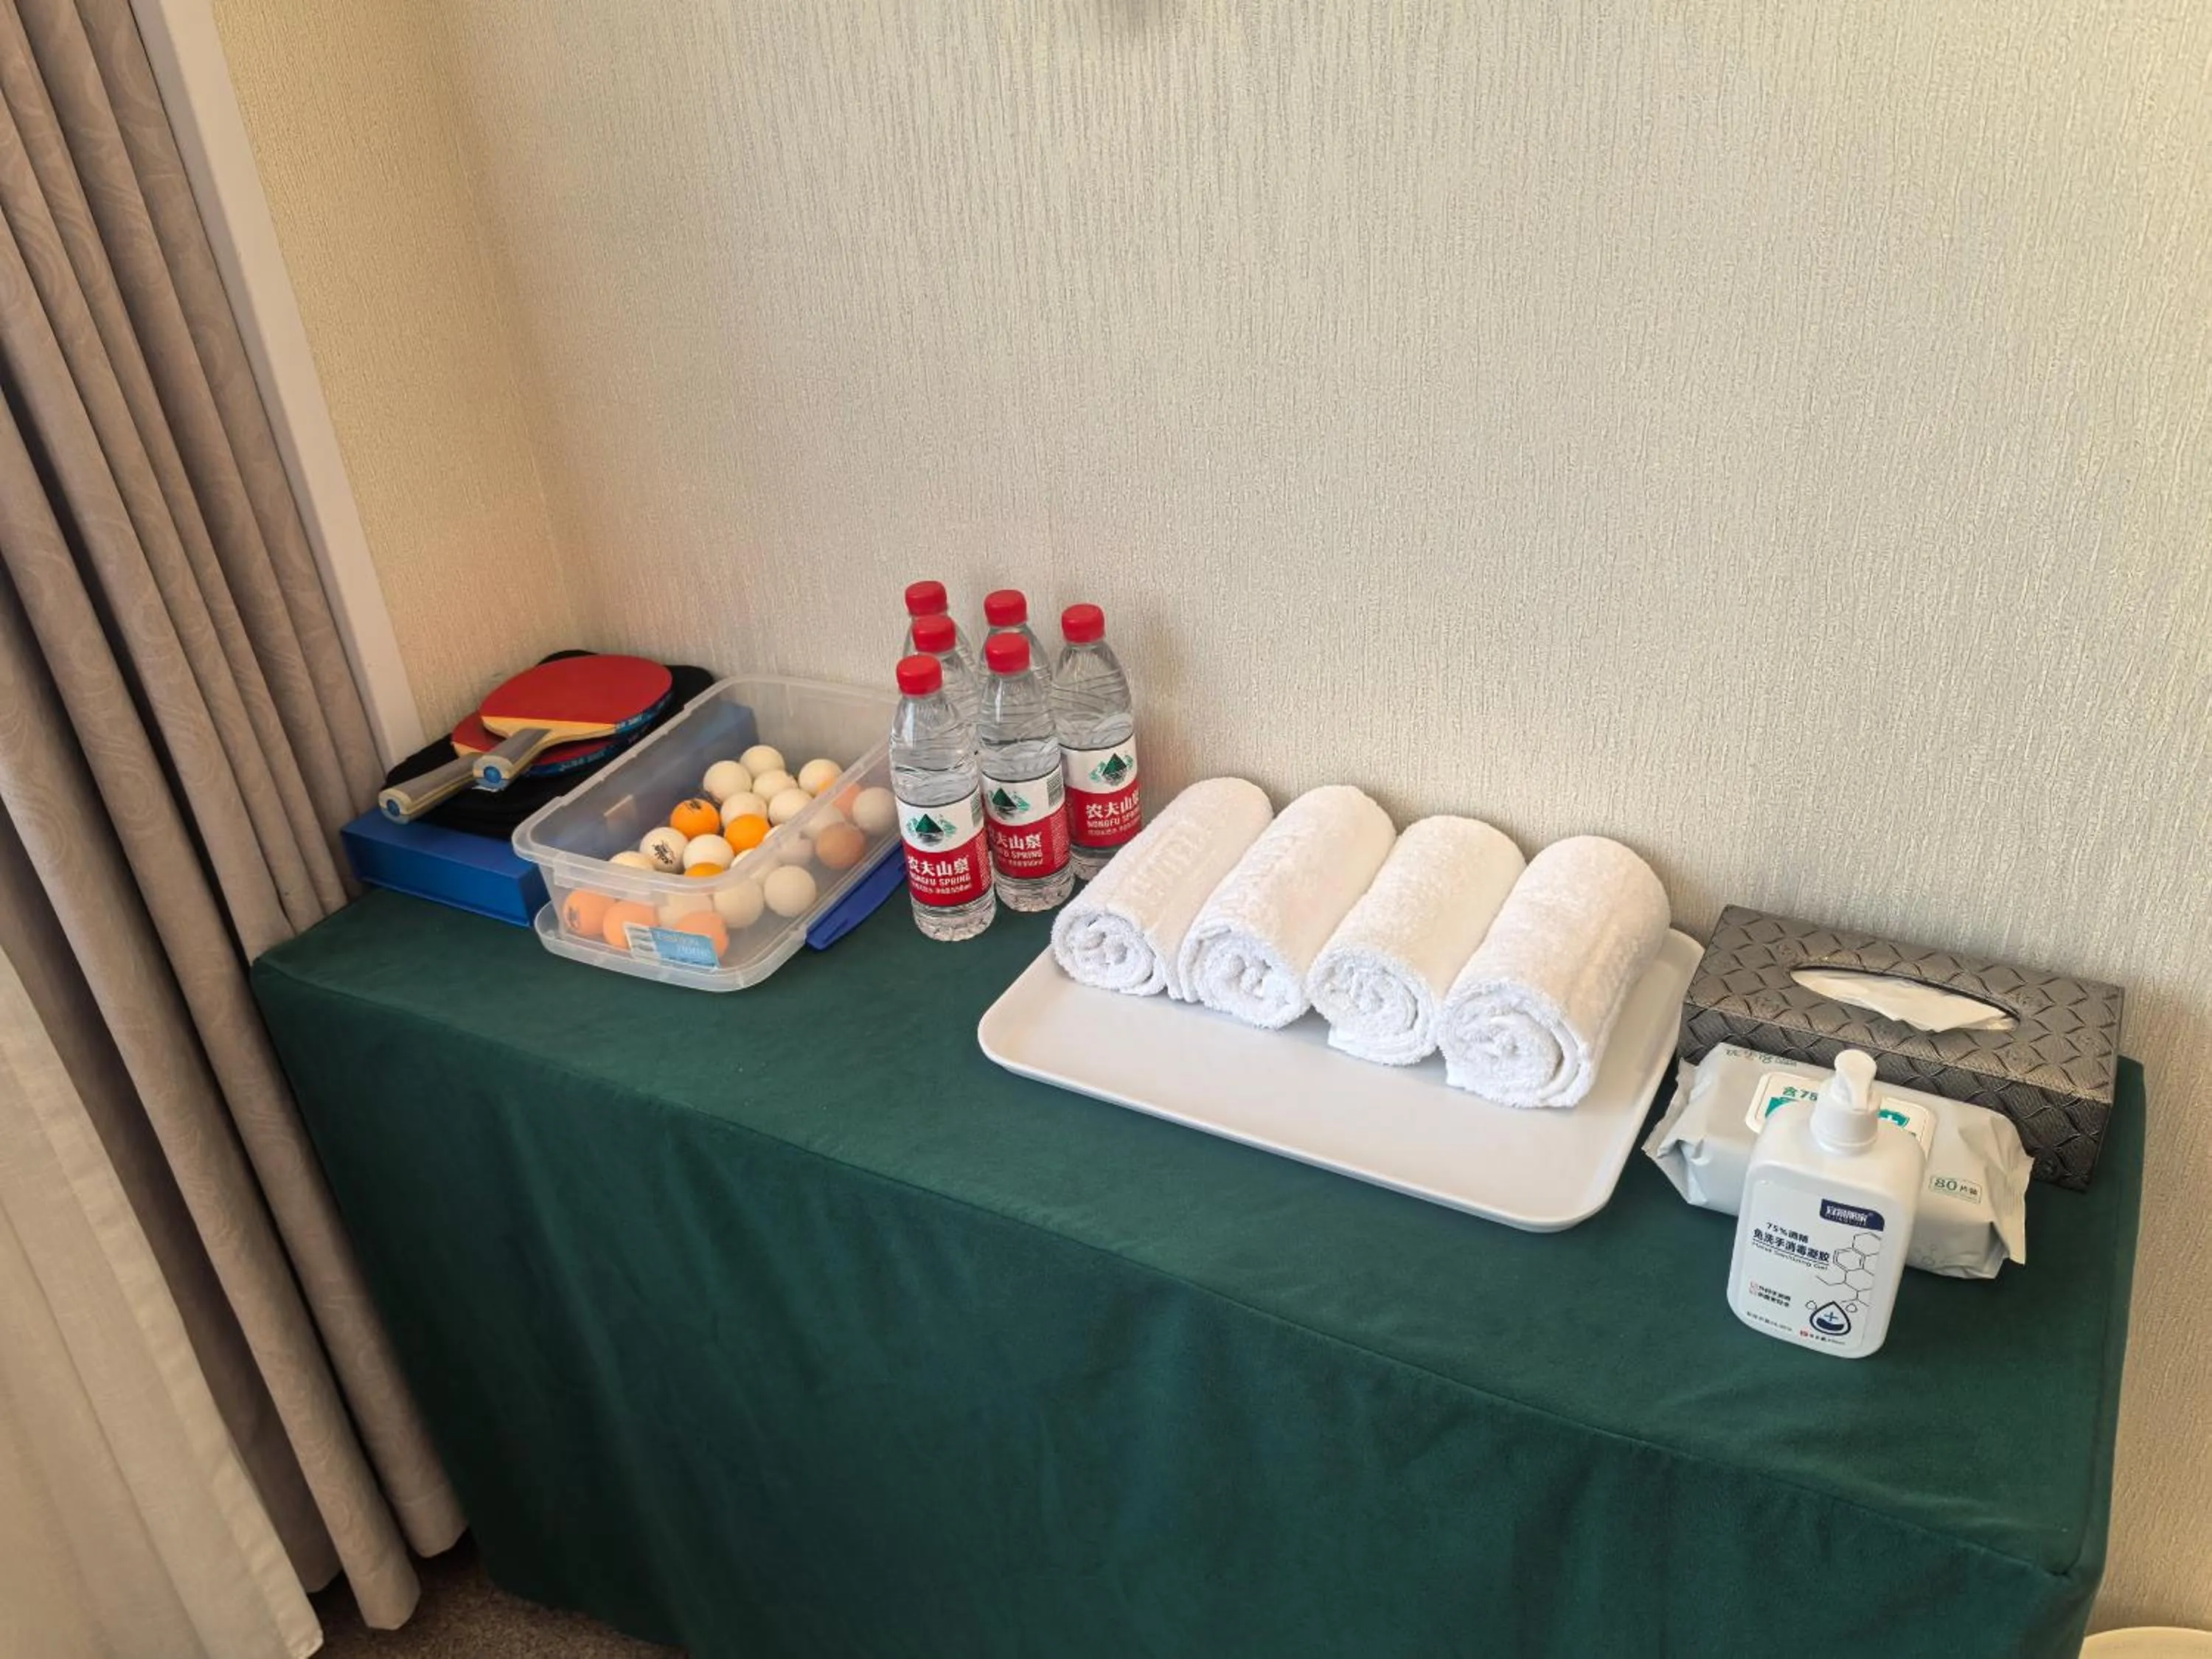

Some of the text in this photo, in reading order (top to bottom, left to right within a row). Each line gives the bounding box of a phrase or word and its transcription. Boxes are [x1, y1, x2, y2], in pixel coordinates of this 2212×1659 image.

[908, 855, 970, 877] 农夫山泉
[939, 873, 970, 885] SPRING
